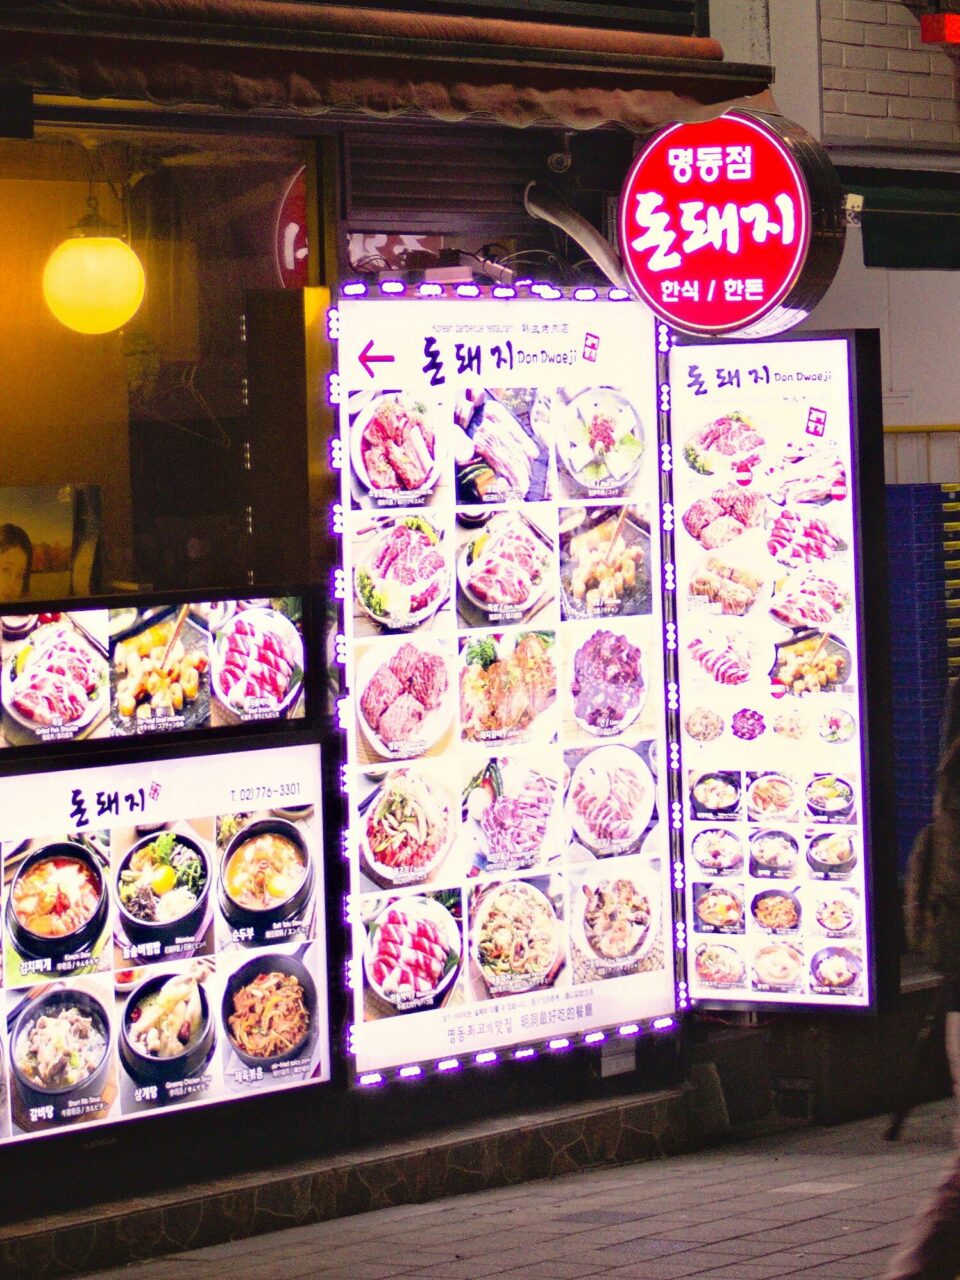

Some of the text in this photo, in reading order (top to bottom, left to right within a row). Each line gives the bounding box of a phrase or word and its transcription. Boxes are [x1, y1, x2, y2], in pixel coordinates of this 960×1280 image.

[666, 145, 753, 184] 명동점
[660, 280, 700, 303] 한식
[723, 278, 764, 302] 한돈
[517, 350, 538, 364] Don
[541, 349, 578, 366] Dwaeji
[774, 372, 794, 382] Don
[796, 371, 832, 382] Dwaeji
[20, 957, 52, 976] 김치찌개
